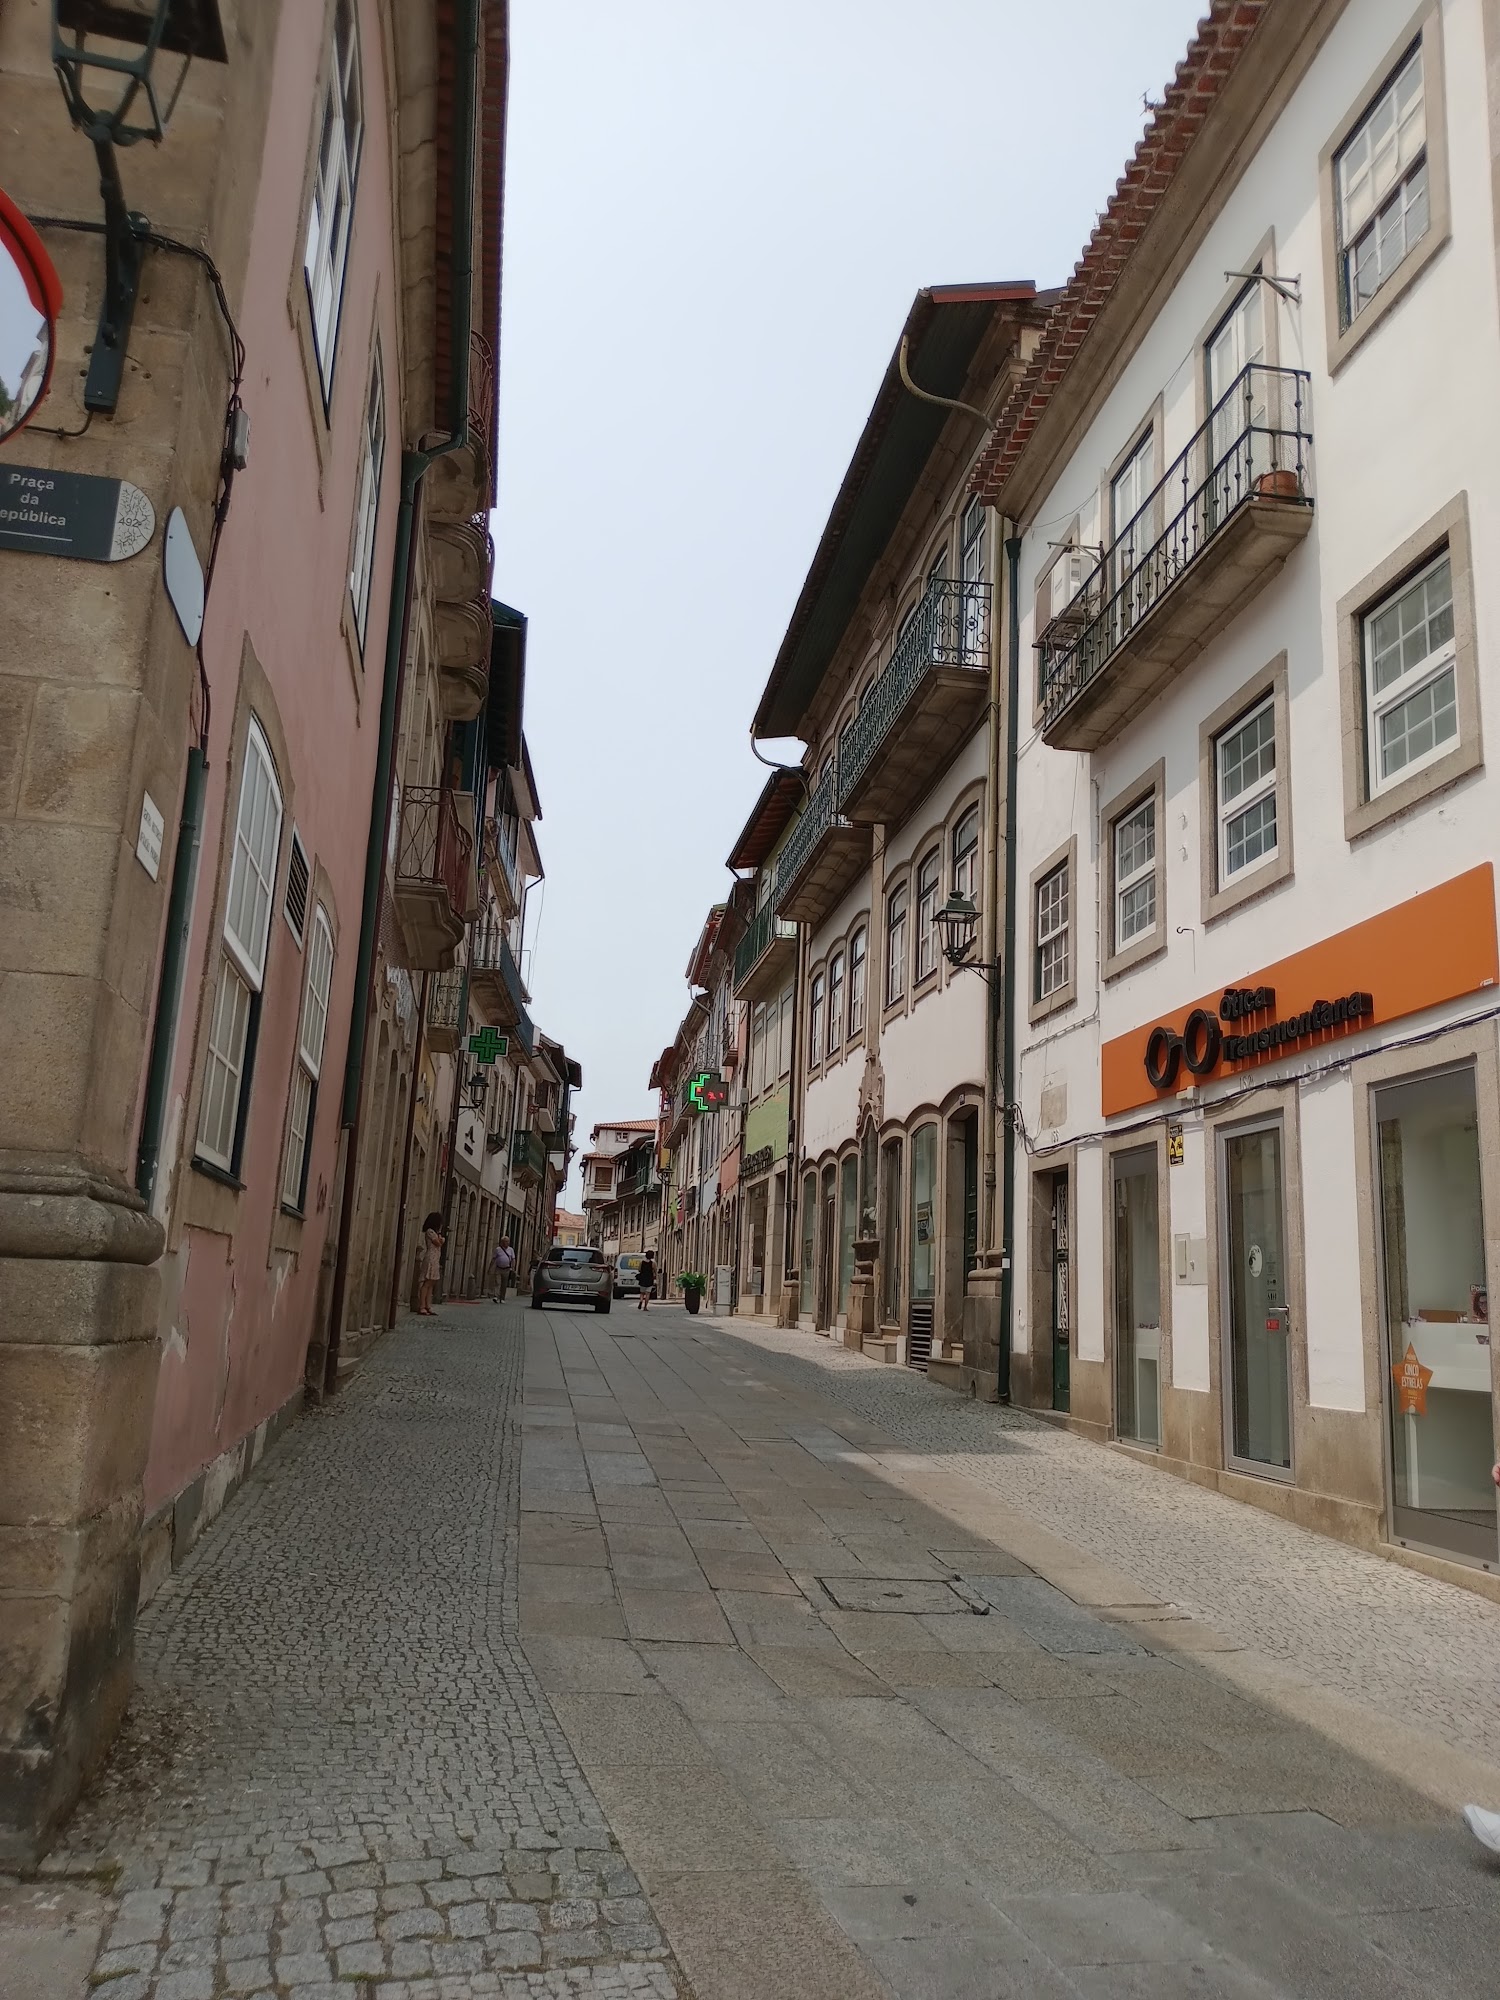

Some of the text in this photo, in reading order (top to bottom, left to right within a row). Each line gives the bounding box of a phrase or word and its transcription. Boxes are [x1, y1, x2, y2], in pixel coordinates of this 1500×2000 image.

[9, 473, 55, 492] Praça
[20, 492, 40, 506] da
[1220, 992, 1371, 1061] Transmontana
[1404, 1363, 1420, 1377] CINCO
[1401, 1376, 1424, 1390] ESTRELAS
